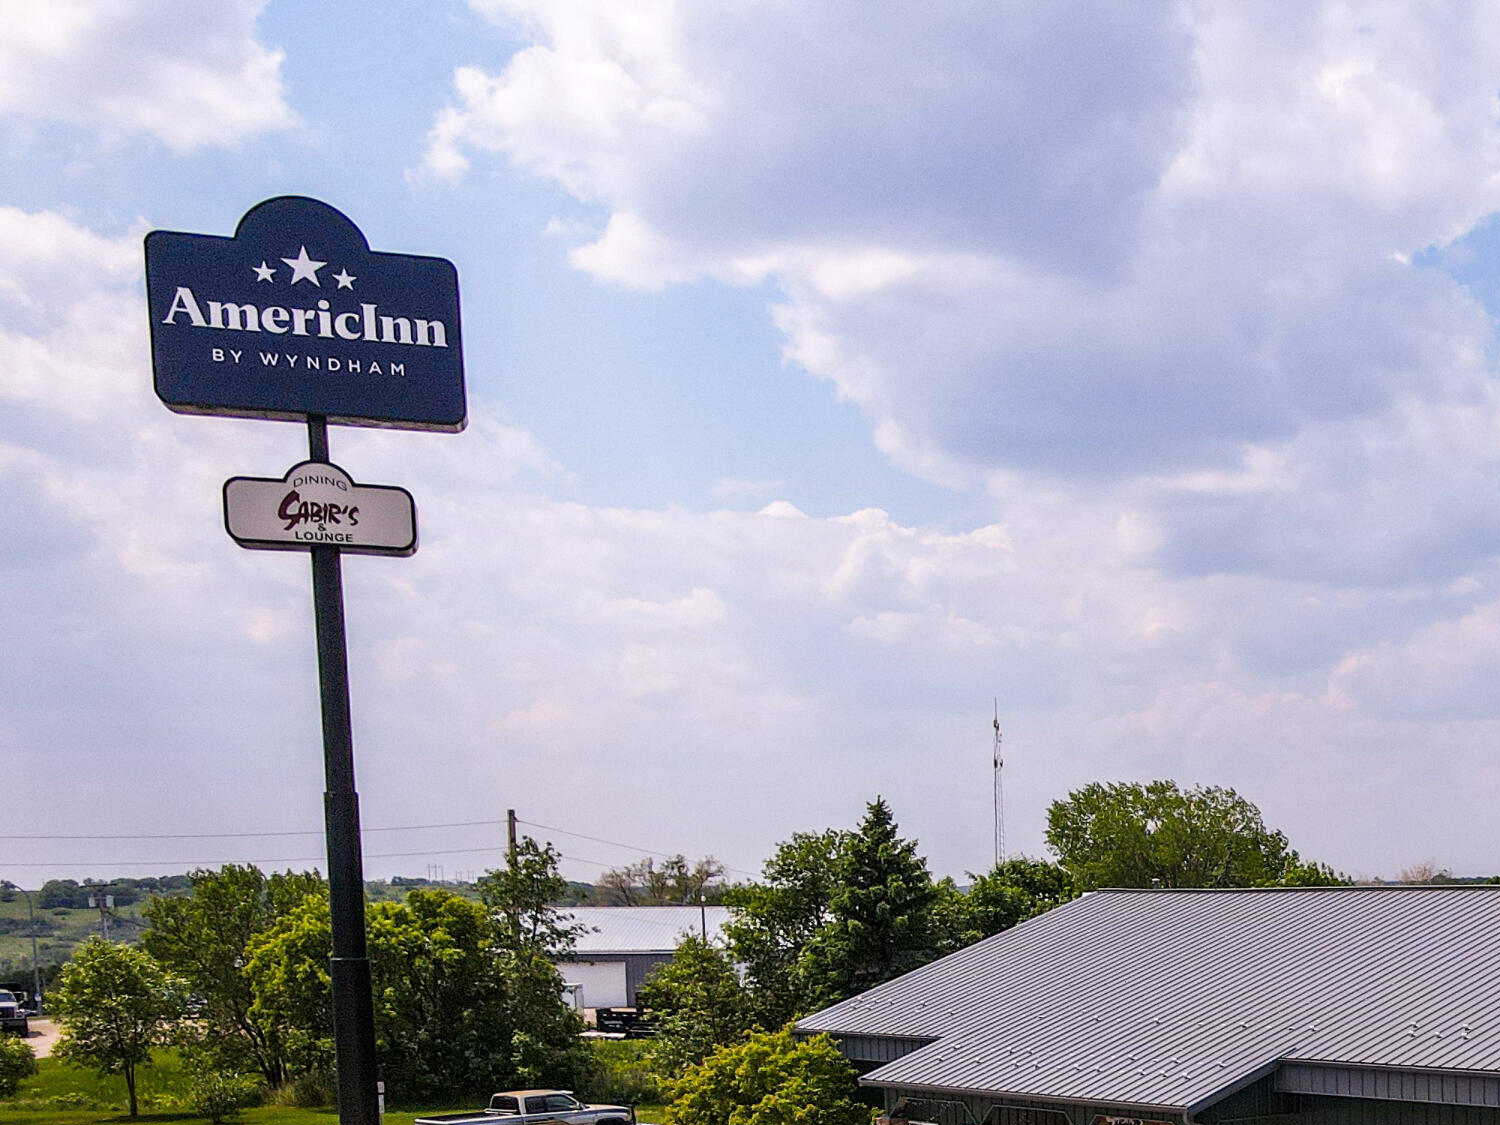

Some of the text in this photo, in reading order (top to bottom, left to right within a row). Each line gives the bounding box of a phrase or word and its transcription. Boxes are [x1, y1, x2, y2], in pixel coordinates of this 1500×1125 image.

[162, 286, 449, 348] AmericInn
[212, 348, 405, 376] BY WYNDHAM
[293, 475, 348, 492] DINING
[318, 522, 327, 532] &
[295, 531, 353, 543] LOUNGE
